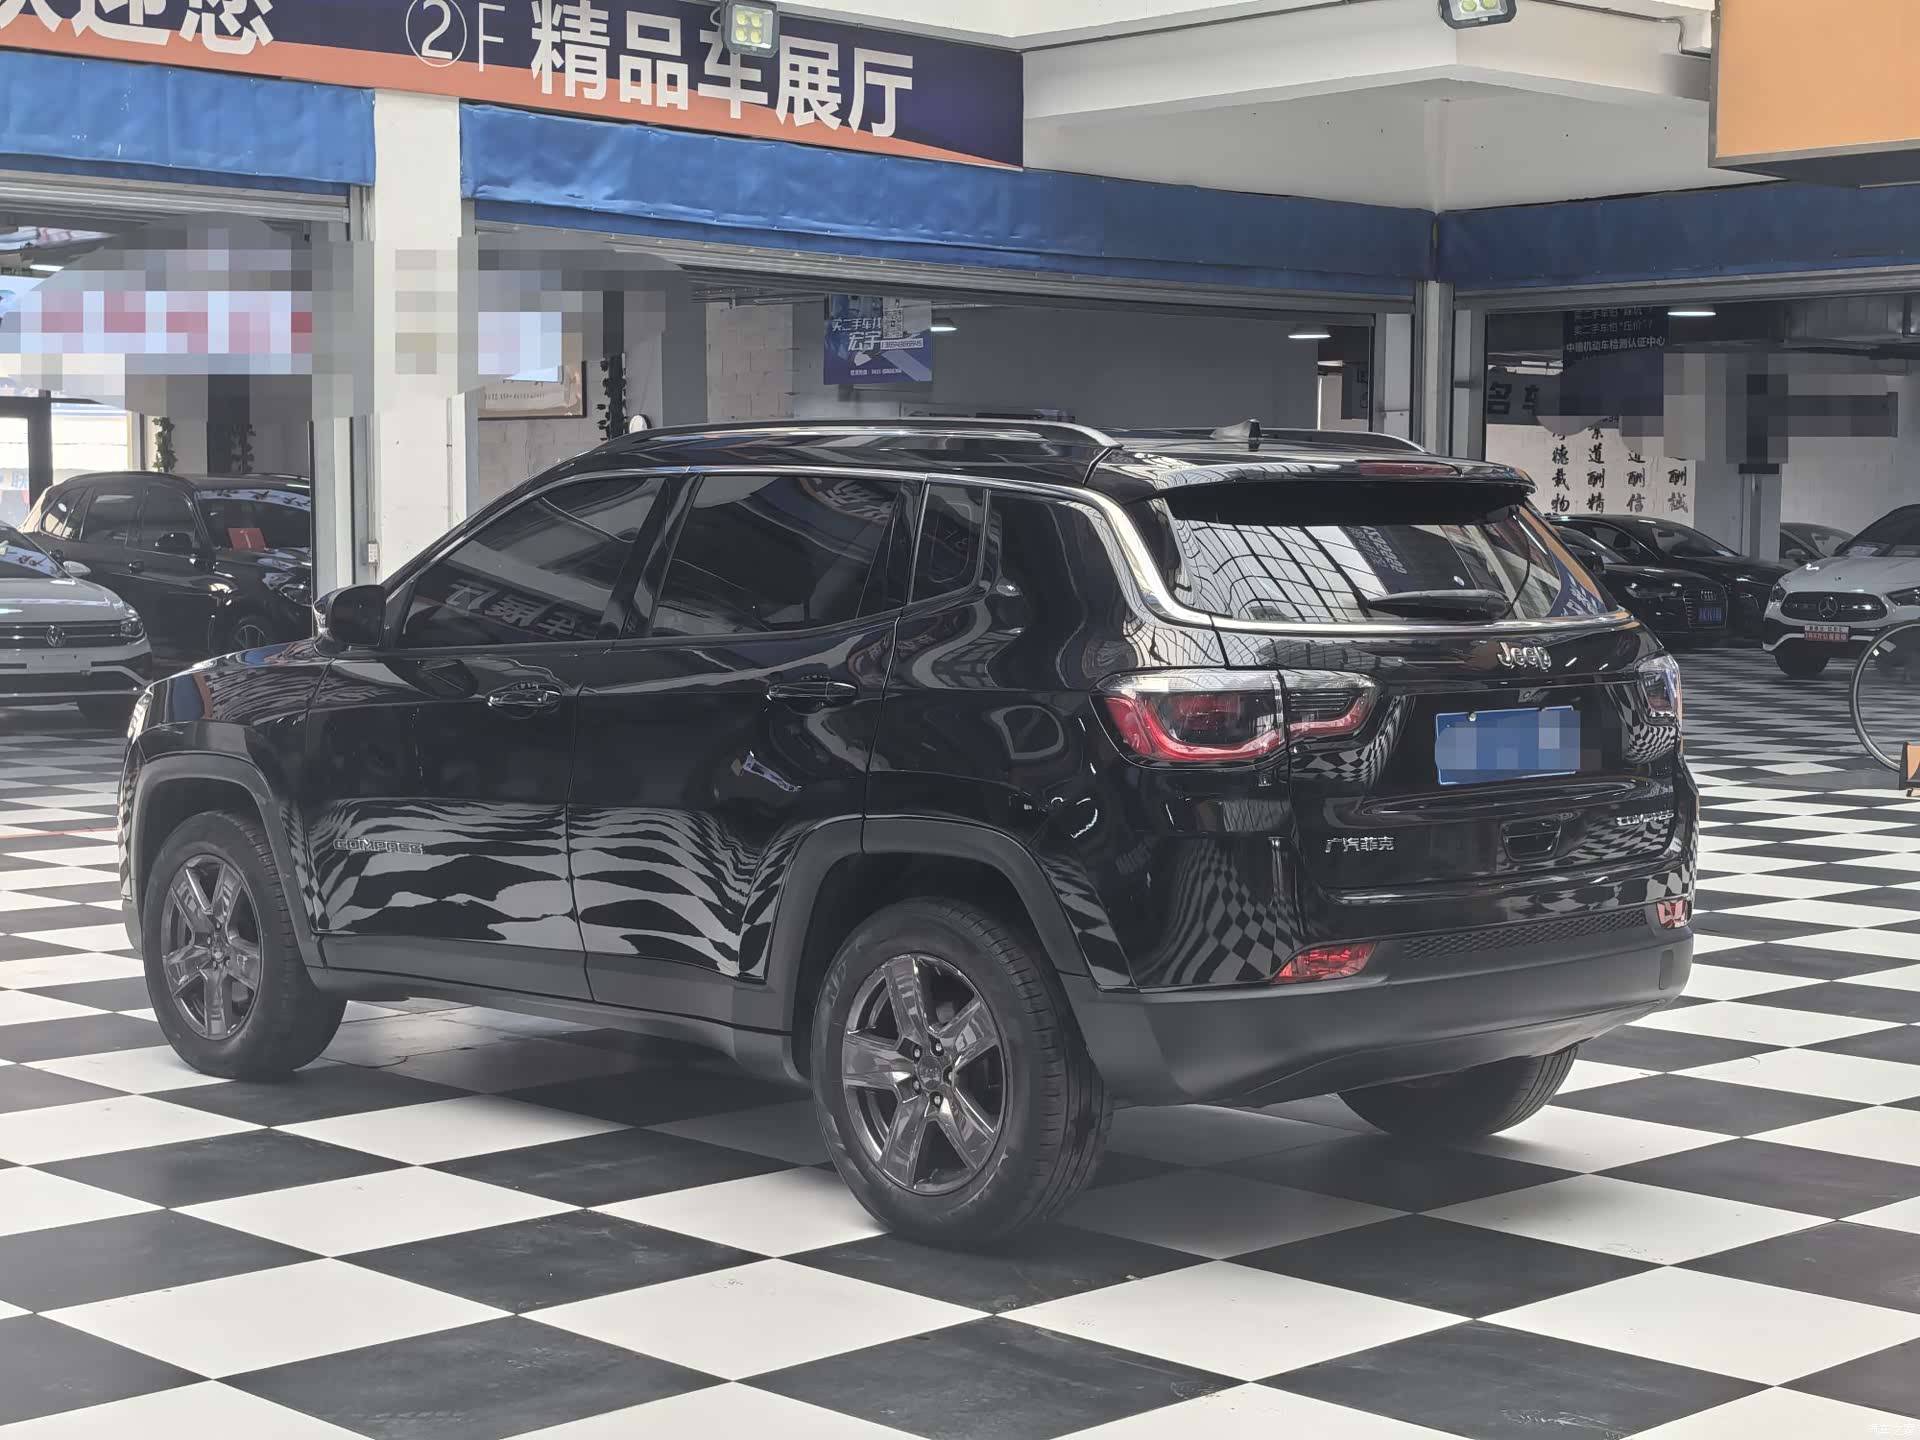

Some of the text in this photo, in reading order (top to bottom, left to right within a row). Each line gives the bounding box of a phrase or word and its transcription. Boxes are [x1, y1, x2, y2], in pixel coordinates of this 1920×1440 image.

[530, 0, 914, 138] 精品车展厅
[1497, 641, 1552, 672] Jeep
[333, 838, 424, 855] COMPASS
[1325, 836, 1395, 853] 广汽菲克
